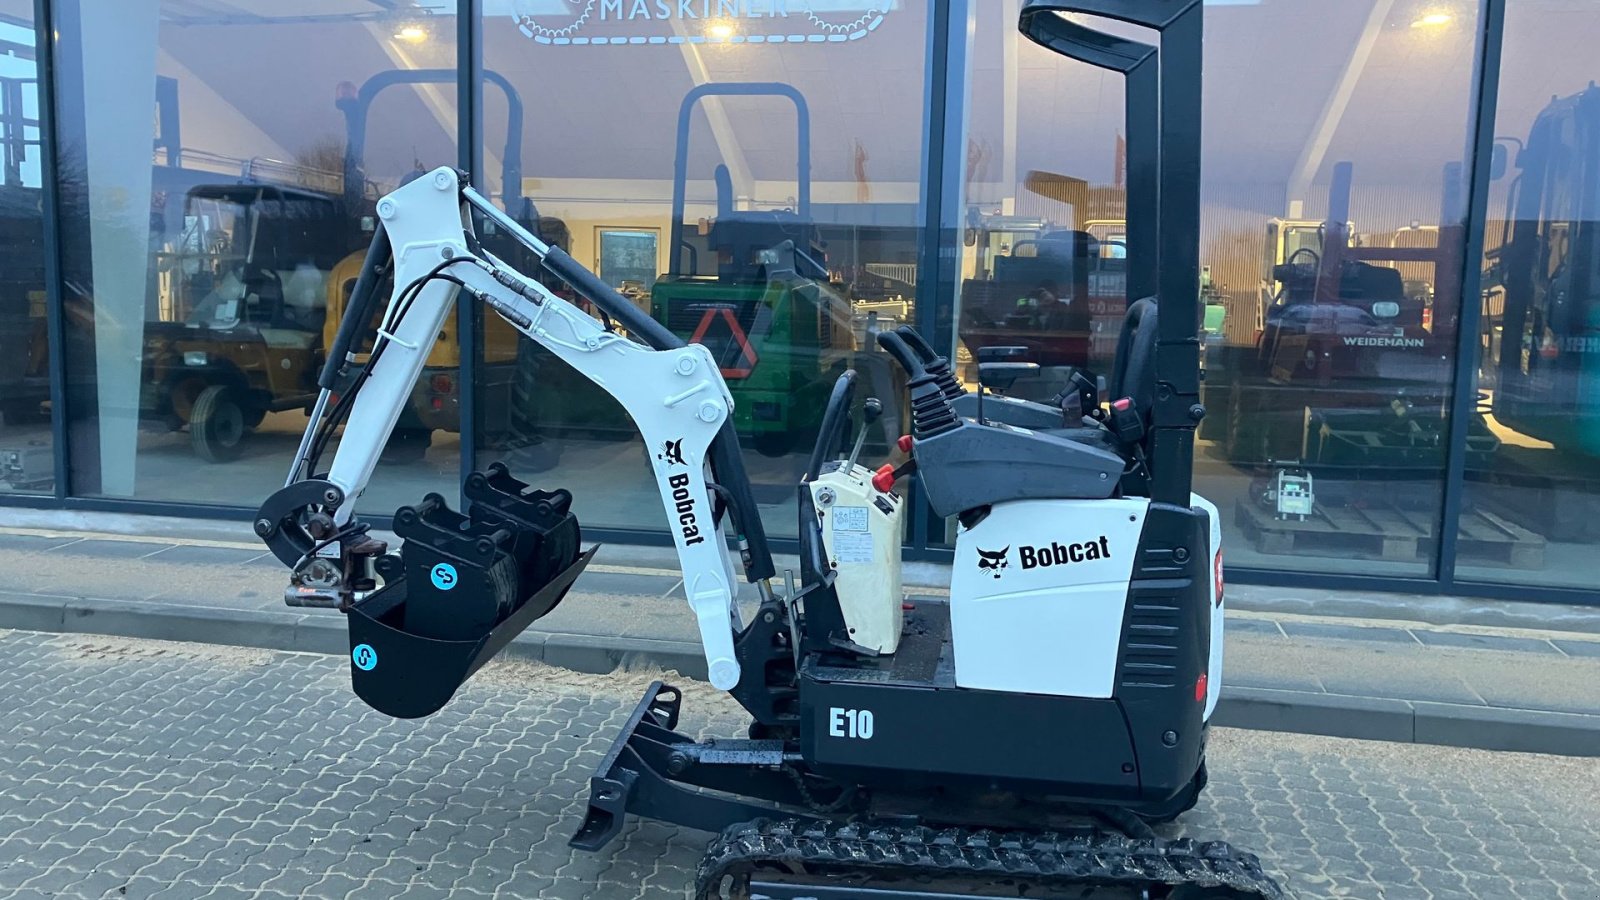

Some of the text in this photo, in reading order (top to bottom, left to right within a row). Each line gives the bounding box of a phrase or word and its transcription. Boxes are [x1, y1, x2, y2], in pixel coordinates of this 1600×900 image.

[600, 0, 788, 20] MASKINER
[1343, 336, 1425, 348] WEIDEMANN
[668, 472, 705, 547] Bobcat
[1019, 535, 1111, 570] Bobcat
[829, 707, 874, 740] E10
